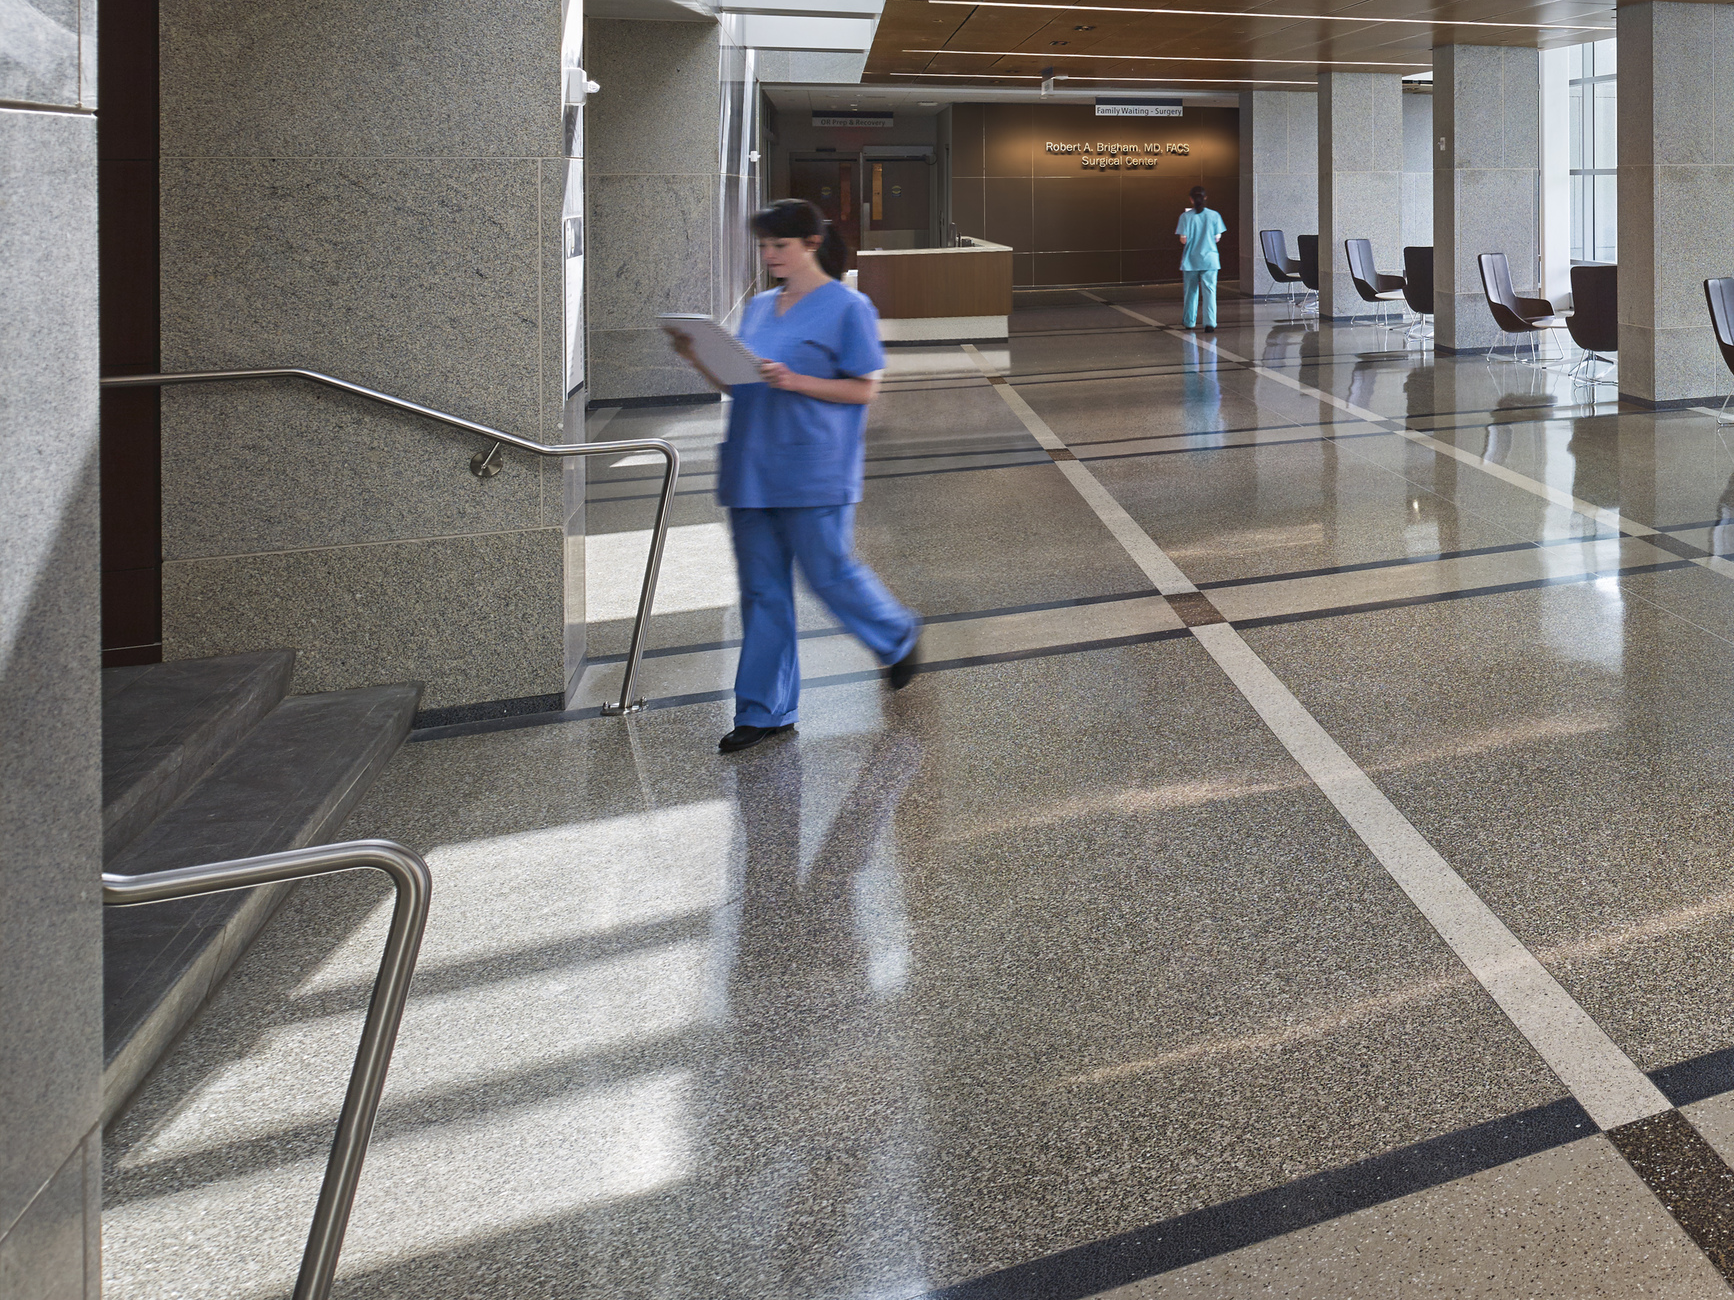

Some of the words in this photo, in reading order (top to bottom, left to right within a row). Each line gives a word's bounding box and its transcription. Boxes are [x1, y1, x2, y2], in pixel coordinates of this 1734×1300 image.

[1097, 107, 1120, 116] Family
[1121, 107, 1149, 116] Waiting
[1155, 107, 1182, 116] Surgery
[832, 118, 848, 126] Prep
[855, 118, 886, 126] Recovery
[1045, 141, 1081, 152] Robert
[1083, 142, 1094, 152] A.
[1096, 142, 1141, 154] Brigham,
[1144, 143, 1163, 153] MD,
[1166, 143, 1190, 153] FACS
[1081, 155, 1123, 168] Surgical
[1125, 156, 1158, 166] Center
